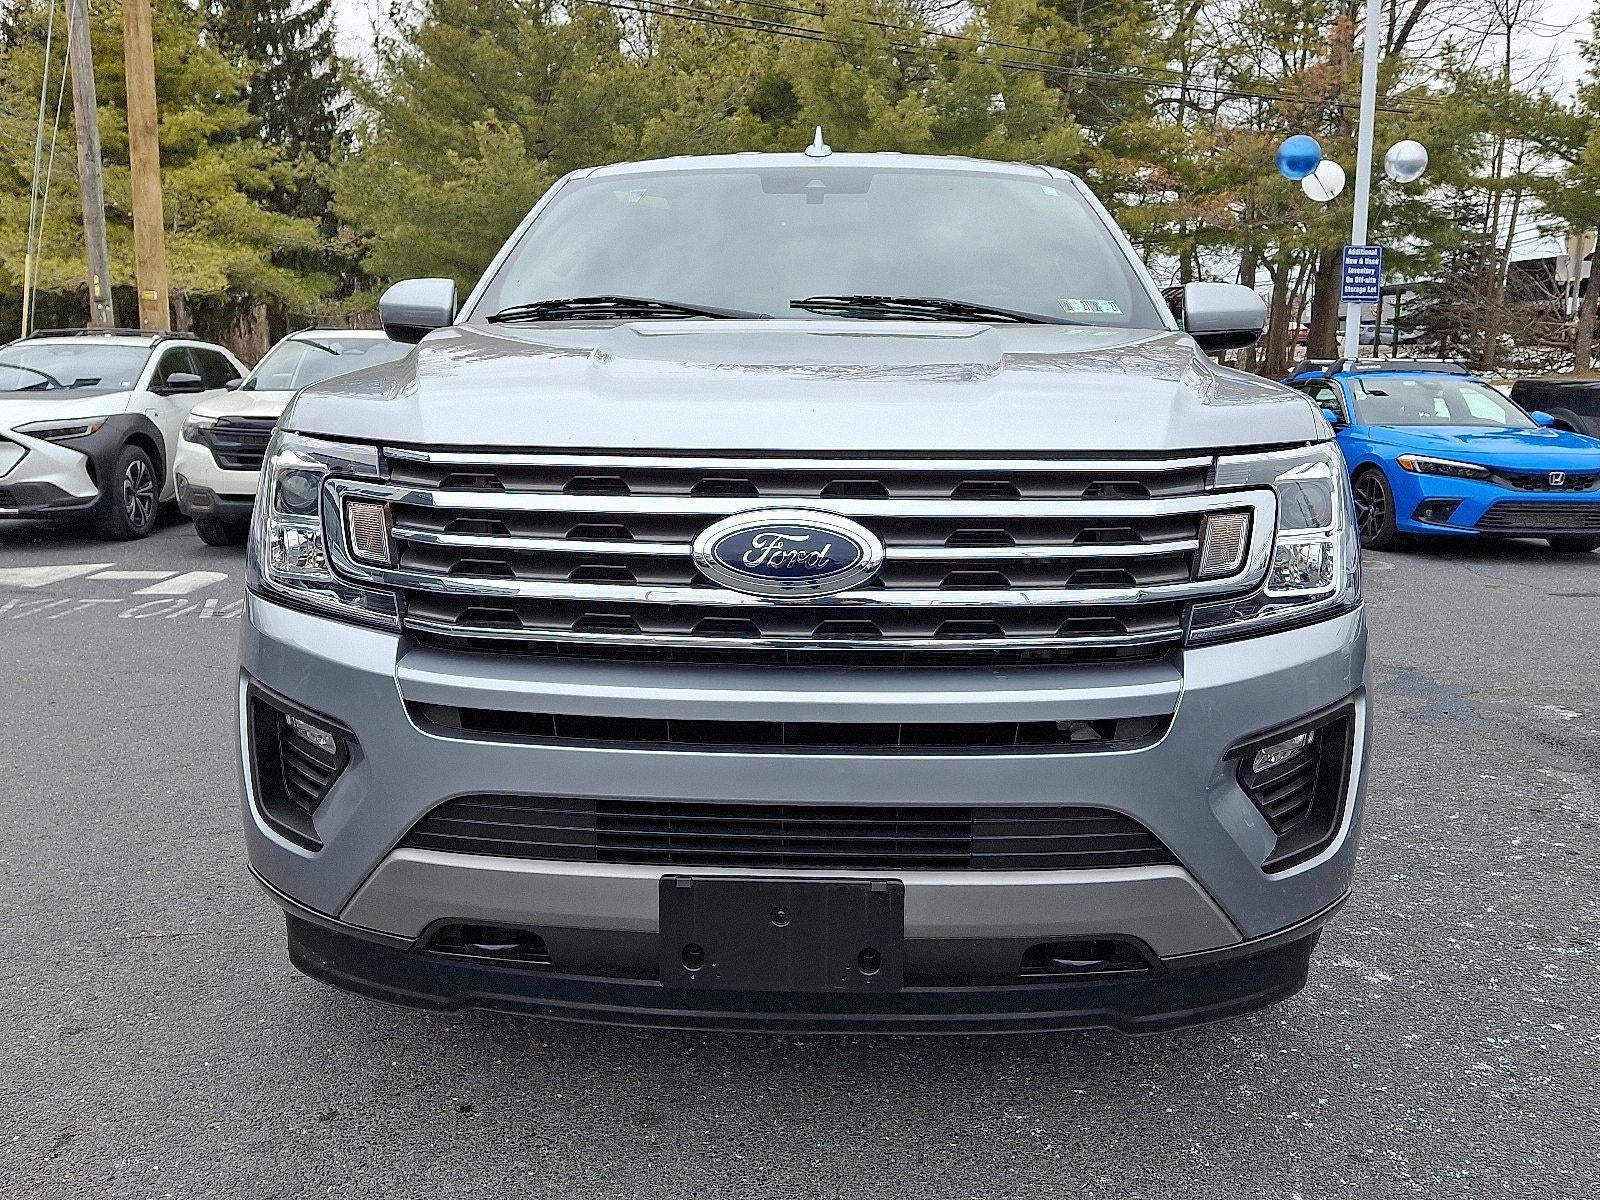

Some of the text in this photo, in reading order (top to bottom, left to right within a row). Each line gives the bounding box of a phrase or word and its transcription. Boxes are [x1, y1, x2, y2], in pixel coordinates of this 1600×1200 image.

[1348, 267, 1375, 275] Inventory
[1344, 285, 1377, 294] Storage Lot
[742, 532, 832, 569] Ford
